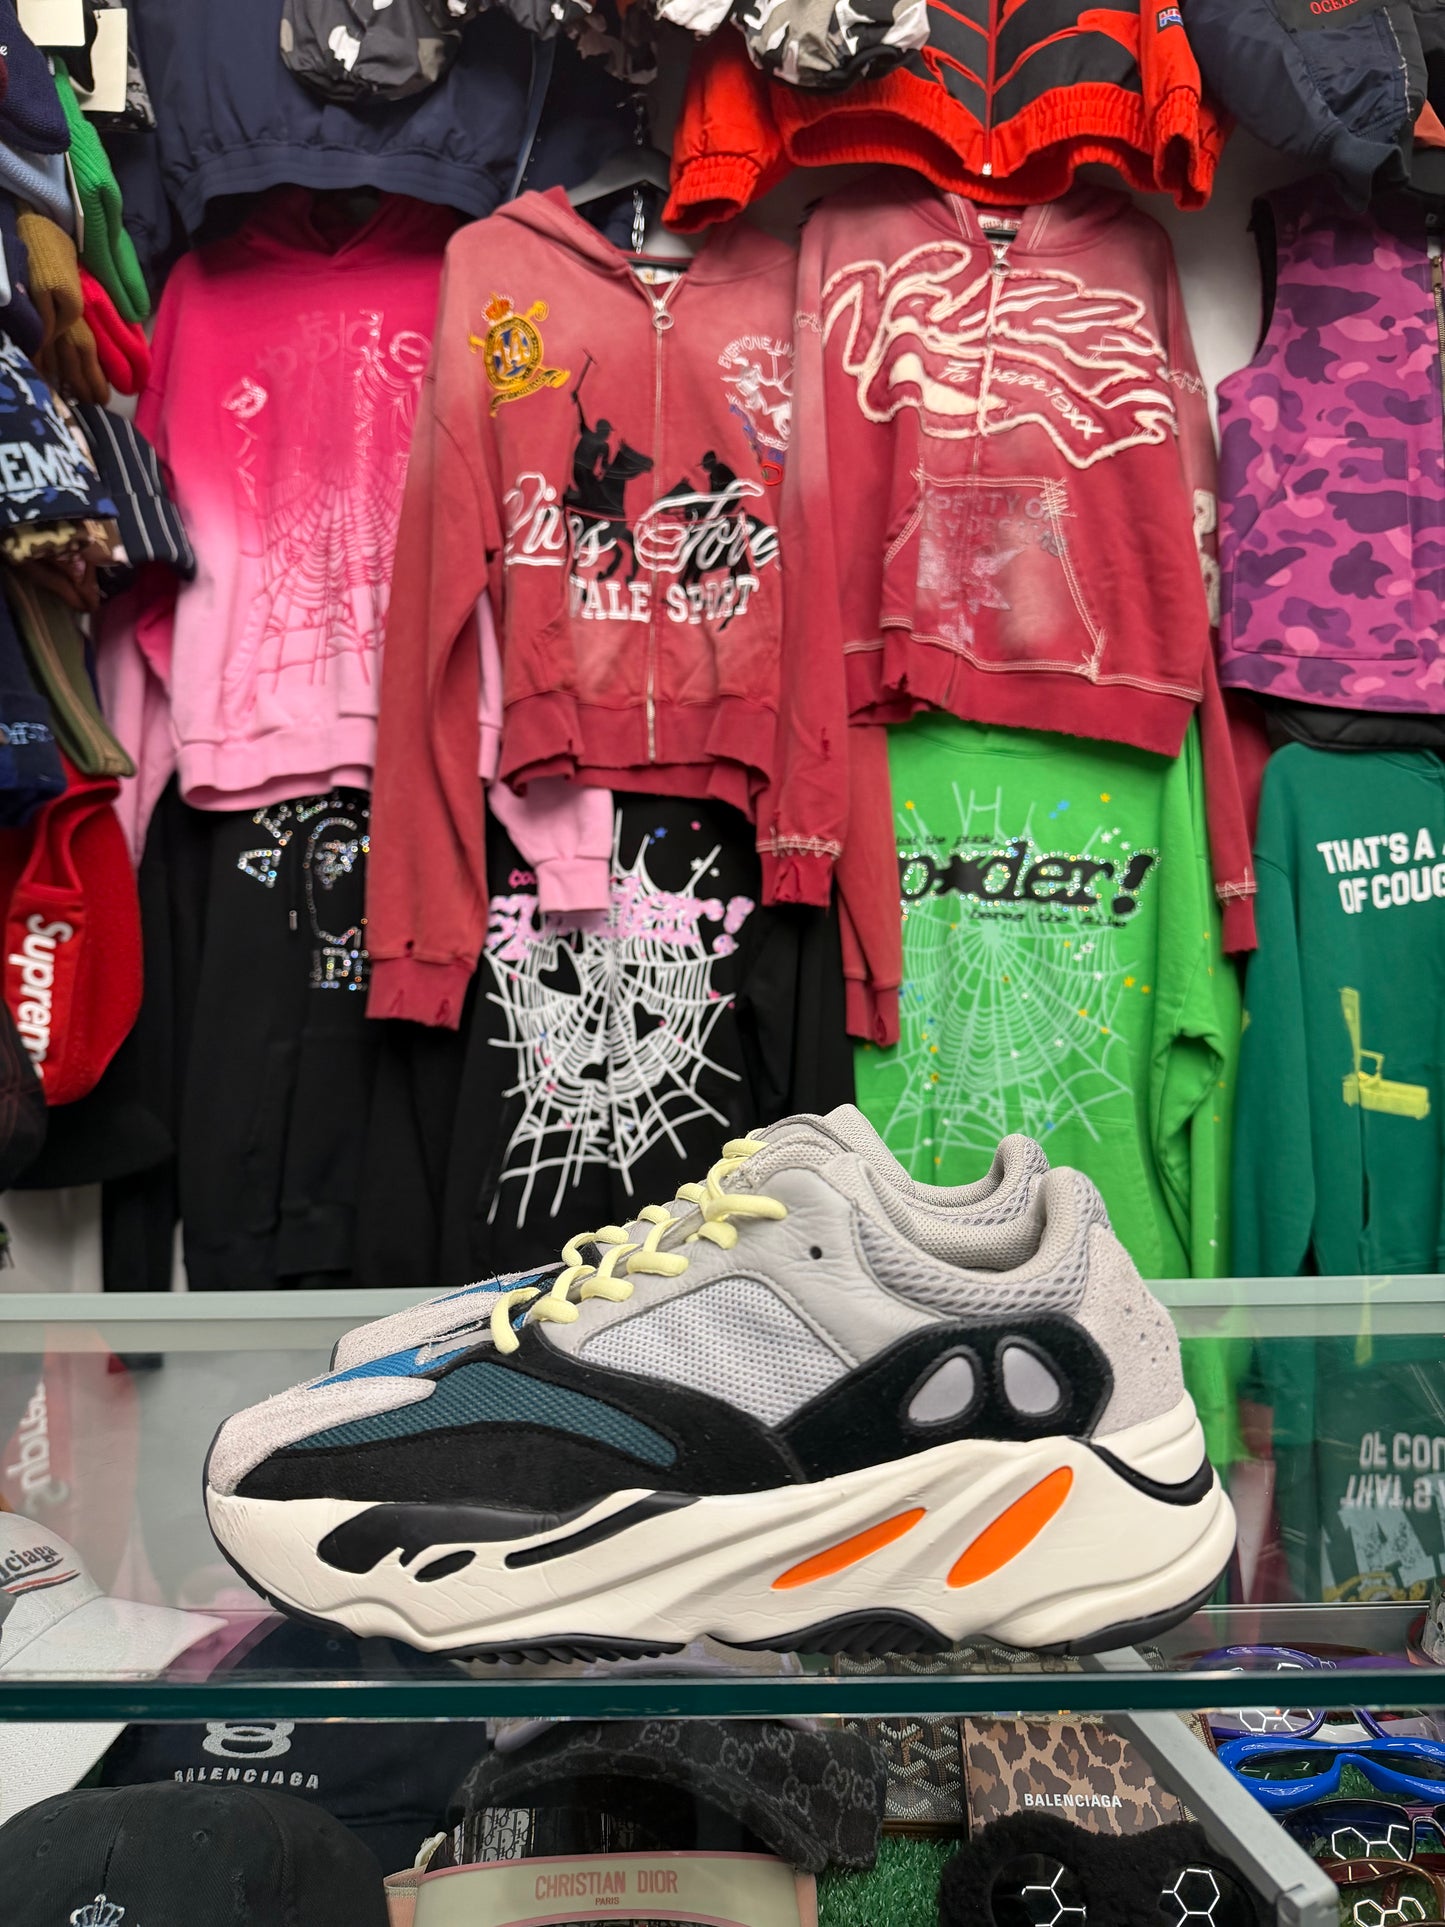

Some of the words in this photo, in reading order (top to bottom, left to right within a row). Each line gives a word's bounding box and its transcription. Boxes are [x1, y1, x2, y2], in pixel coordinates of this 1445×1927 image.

[1316, 832, 1410, 874] THAT'S
[1413, 827, 1436, 861] A
[1338, 876, 1368, 915] OF
[174, 1766, 319, 1790] BALENCIAGA
[1023, 1793, 1123, 1808] BALENCIAGA
[535, 1871, 627, 1901] CHRISTIAN
[637, 1869, 678, 1894] DIOR
[595, 1897, 620, 1906] PARIS
